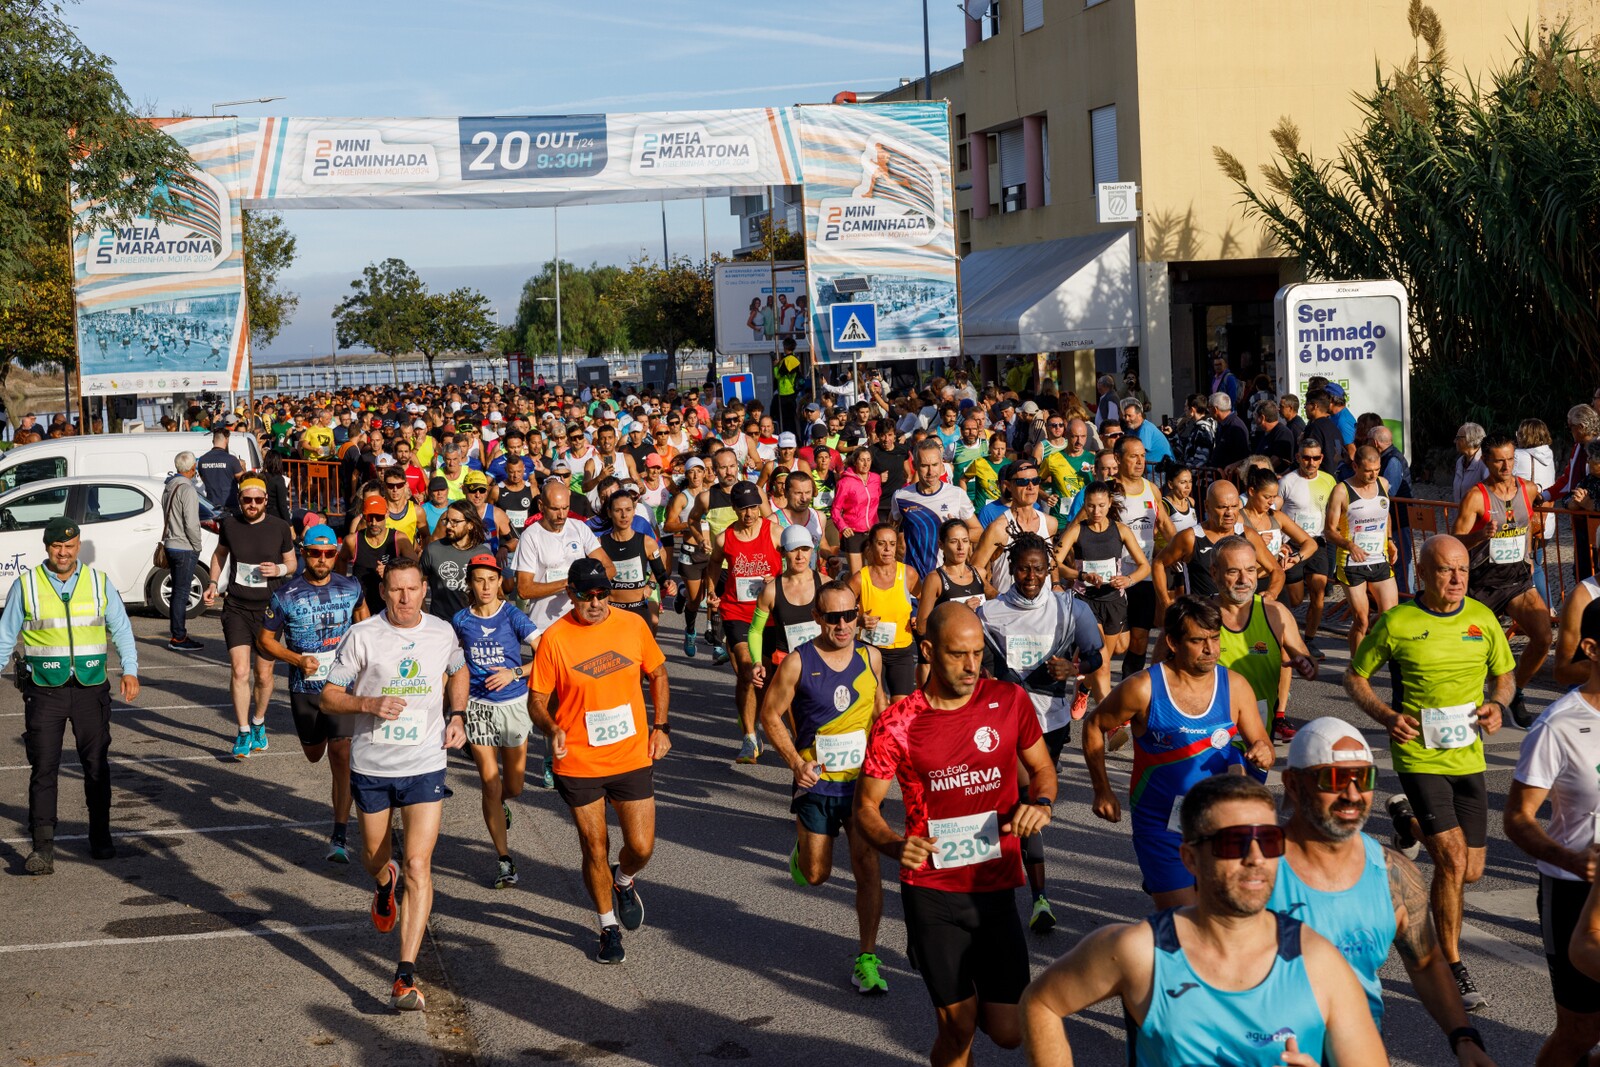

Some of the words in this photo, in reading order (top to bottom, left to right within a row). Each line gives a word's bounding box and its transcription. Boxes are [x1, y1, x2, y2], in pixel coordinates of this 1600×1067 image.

[660, 131, 701, 145] MEIA
[335, 139, 371, 152] MINI
[468, 130, 531, 171] 20
[658, 144, 750, 159] MARATONA
[332, 154, 428, 168] CAMINHADA
[536, 152, 593, 169] 9:30H
[662, 159, 705, 168] RIBEIRINHA
[707, 159, 731, 167] MOITA
[336, 168, 382, 176] RIBEIRINHA
[384, 167, 410, 176] MOITA
[410, 166, 430, 175] 2024
[845, 205, 876, 218] MINI
[842, 217, 926, 232] CAMINHADA
[118, 227, 160, 241] MEIA
[115, 240, 212, 255] MARATONA
[119, 254, 165, 264] RIBEIRINHA
[168, 254, 192, 264] MOITA
[194, 254, 213, 263] 2024
[1298, 304, 1337, 324] Ser
[1298, 321, 1386, 343] mimado
[1061, 339, 1094, 347] PASTELARIA
[1299, 344, 1312, 364] é
[1316, 340, 1377, 362] bom?
[1358, 542, 1380, 552] 257
[1495, 548, 1520, 561] 225
[614, 569, 639, 580] 213
[614, 581, 635, 589] PRO
[296, 607, 311, 616] C.D.
[312, 605, 326, 613] SAN
[470, 646, 505, 659] BLUE
[1021, 650, 1043, 665] 51
[42, 661, 61, 669] GNR
[86, 659, 100, 668] GNR
[473, 656, 506, 666] ISLAND
[593, 657, 621, 675] RUNNER
[389, 678, 427, 687] PEGADA
[381, 685, 432, 695] RIBEIRINHA
[381, 724, 418, 741] 194
[595, 720, 629, 742] 283
[1440, 724, 1468, 744] 29
[824, 748, 861, 767] 276
[928, 763, 969, 778] COLÉGIO
[930, 766, 1002, 792] MINERVA
[965, 779, 1001, 796] RUNNING
[941, 821, 958, 829] MEIA
[941, 824, 979, 835] MARATONA
[942, 836, 990, 862] 230
